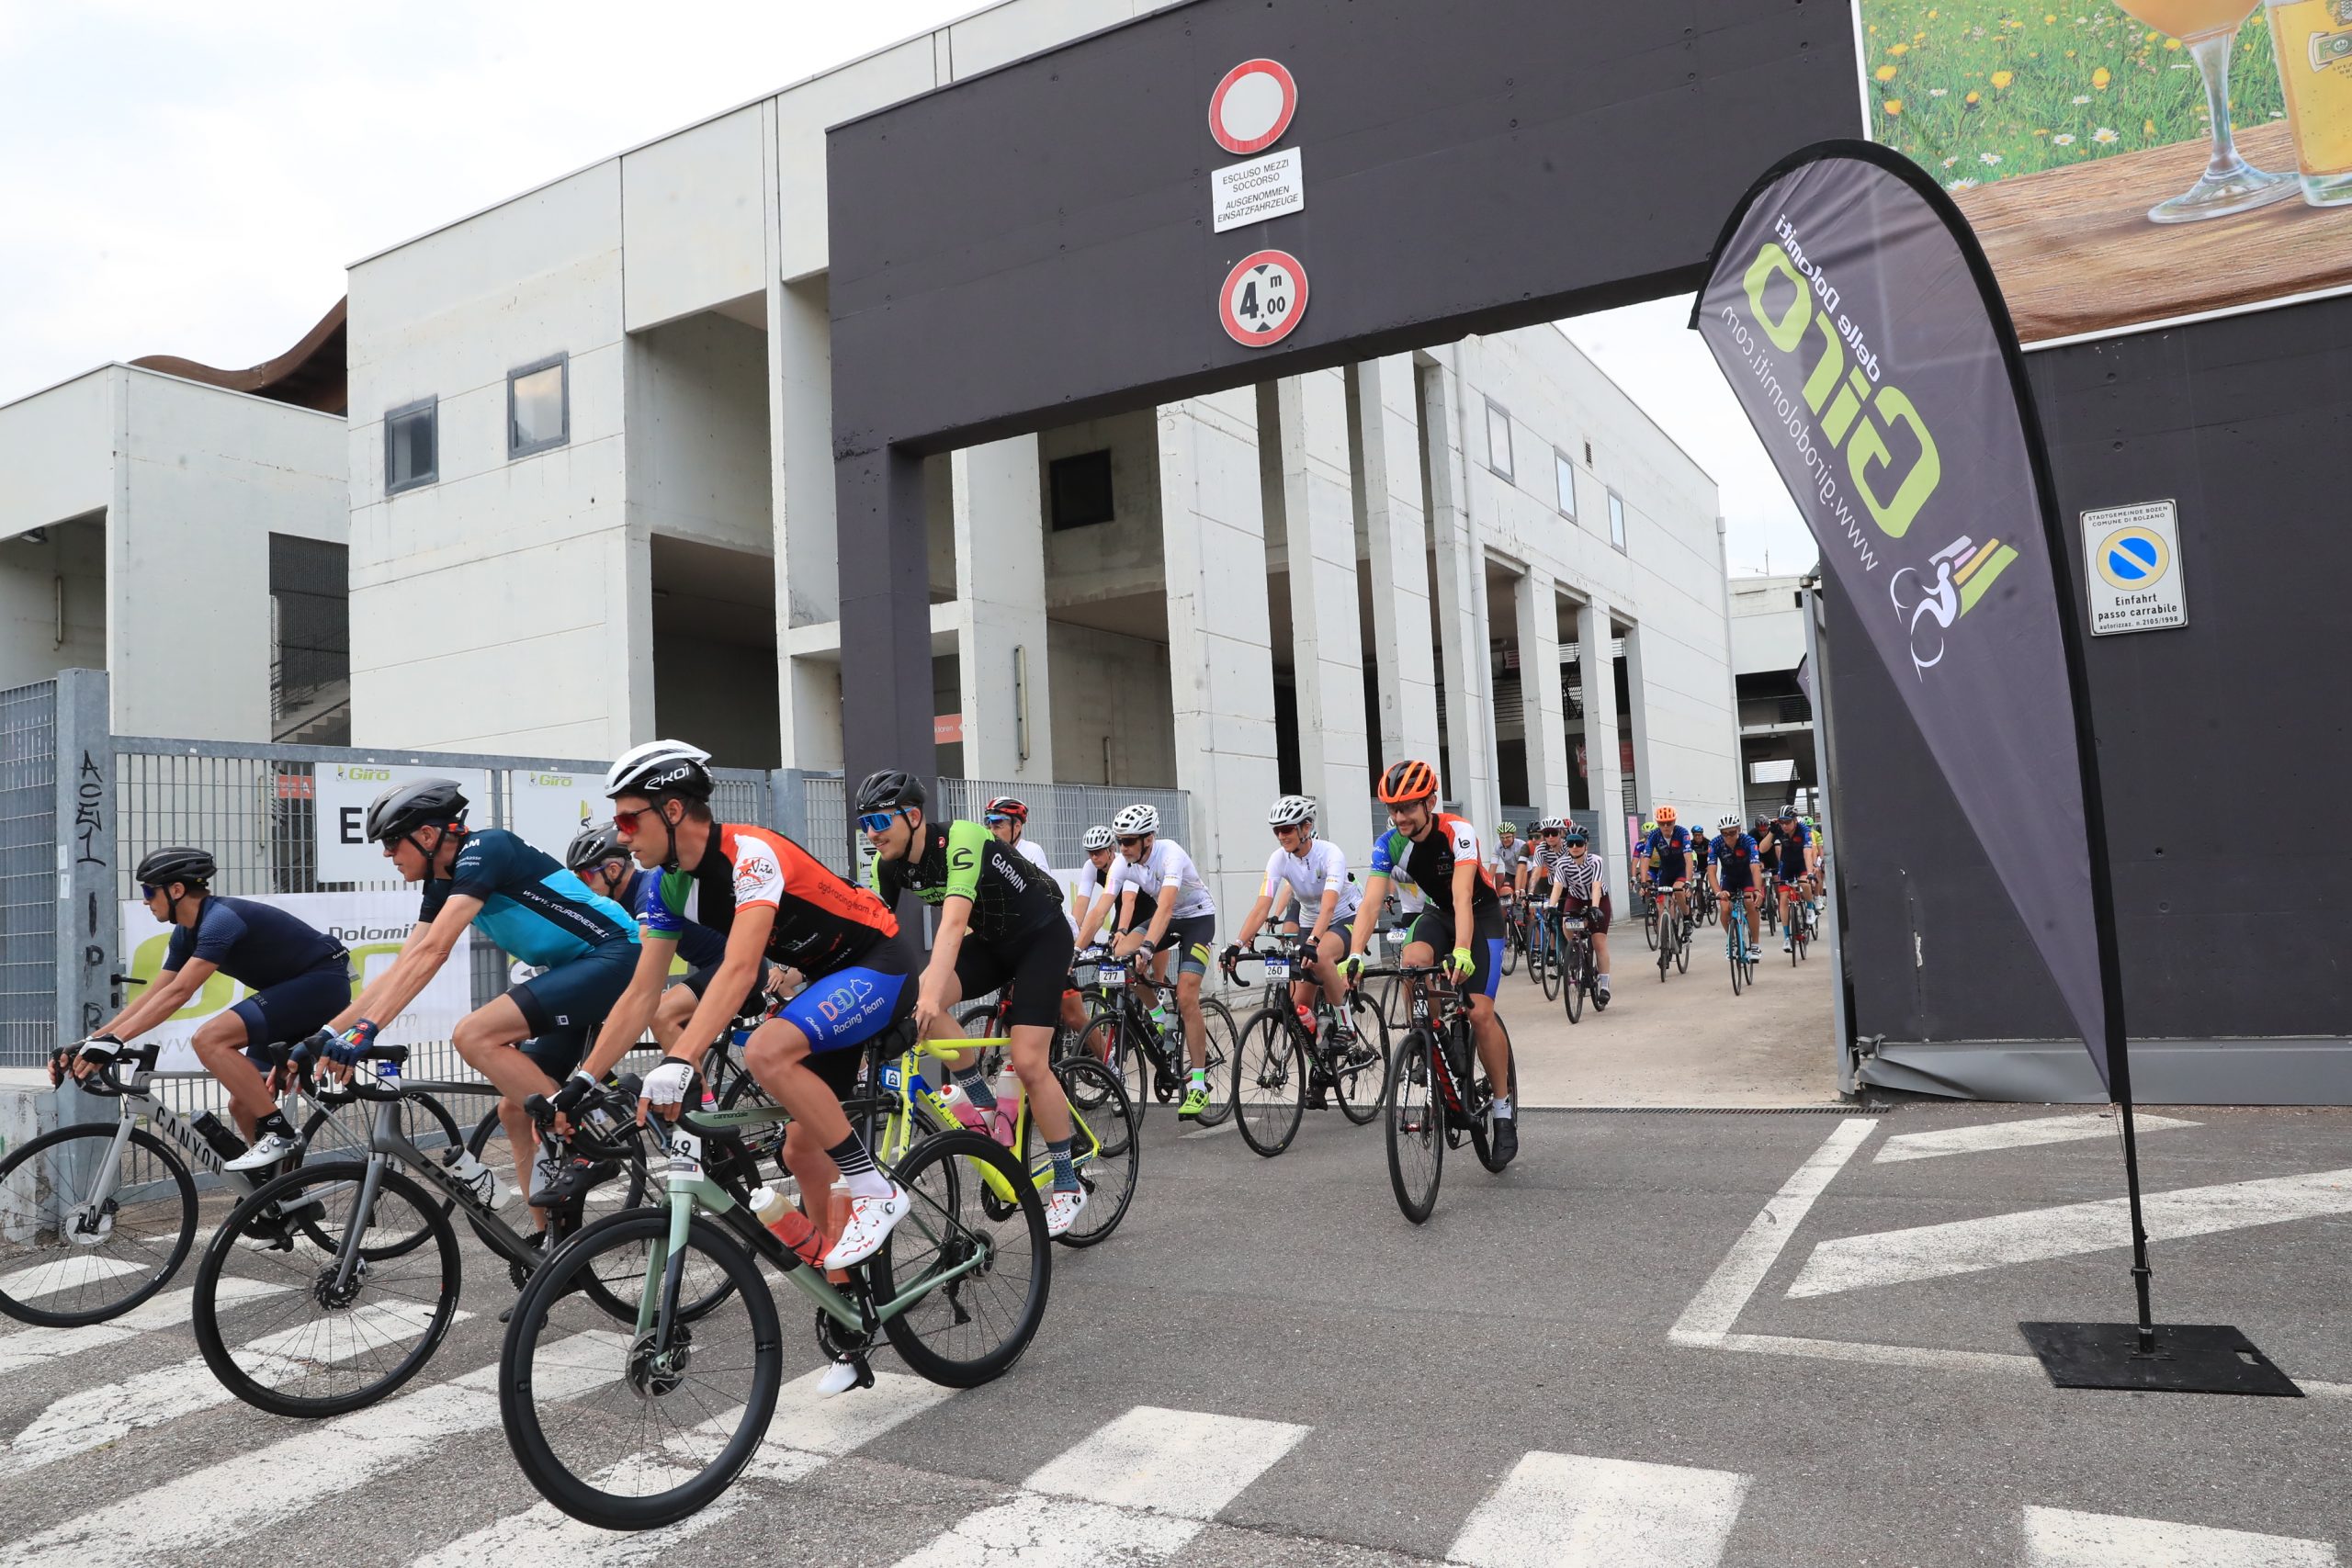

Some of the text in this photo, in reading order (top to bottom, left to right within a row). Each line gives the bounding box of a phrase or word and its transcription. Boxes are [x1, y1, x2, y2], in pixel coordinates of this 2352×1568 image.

[1223, 159, 1289, 185] ESCLUSO MEZZI
[1233, 173, 1280, 193] SOCCORSO
[1226, 186, 1290, 210] AUSGENOMMEN
[1217, 194, 1298, 222] EINSATZFAHRZEUGE
[2088, 509, 2143, 521] STADTGEMEINDE
[2092, 518, 2122, 527] COMUNE
[2132, 513, 2165, 522] BOLZANO
[2115, 593, 2158, 606] Einfahrt
[2098, 604, 2177, 622] passo carrabile
[349, 767, 390, 781] Giro
[539, 774, 572, 786] Giro
[991, 852, 1027, 893] GARMIN
[1103, 972, 1118, 981] 277
[1267, 965, 1283, 976] 260
[832, 997, 885, 1035] Racing Team
[678, 1066, 691, 1091] GIRO
[713, 1111, 749, 1120] cannondale
[155, 1106, 222, 1176] CANYON
